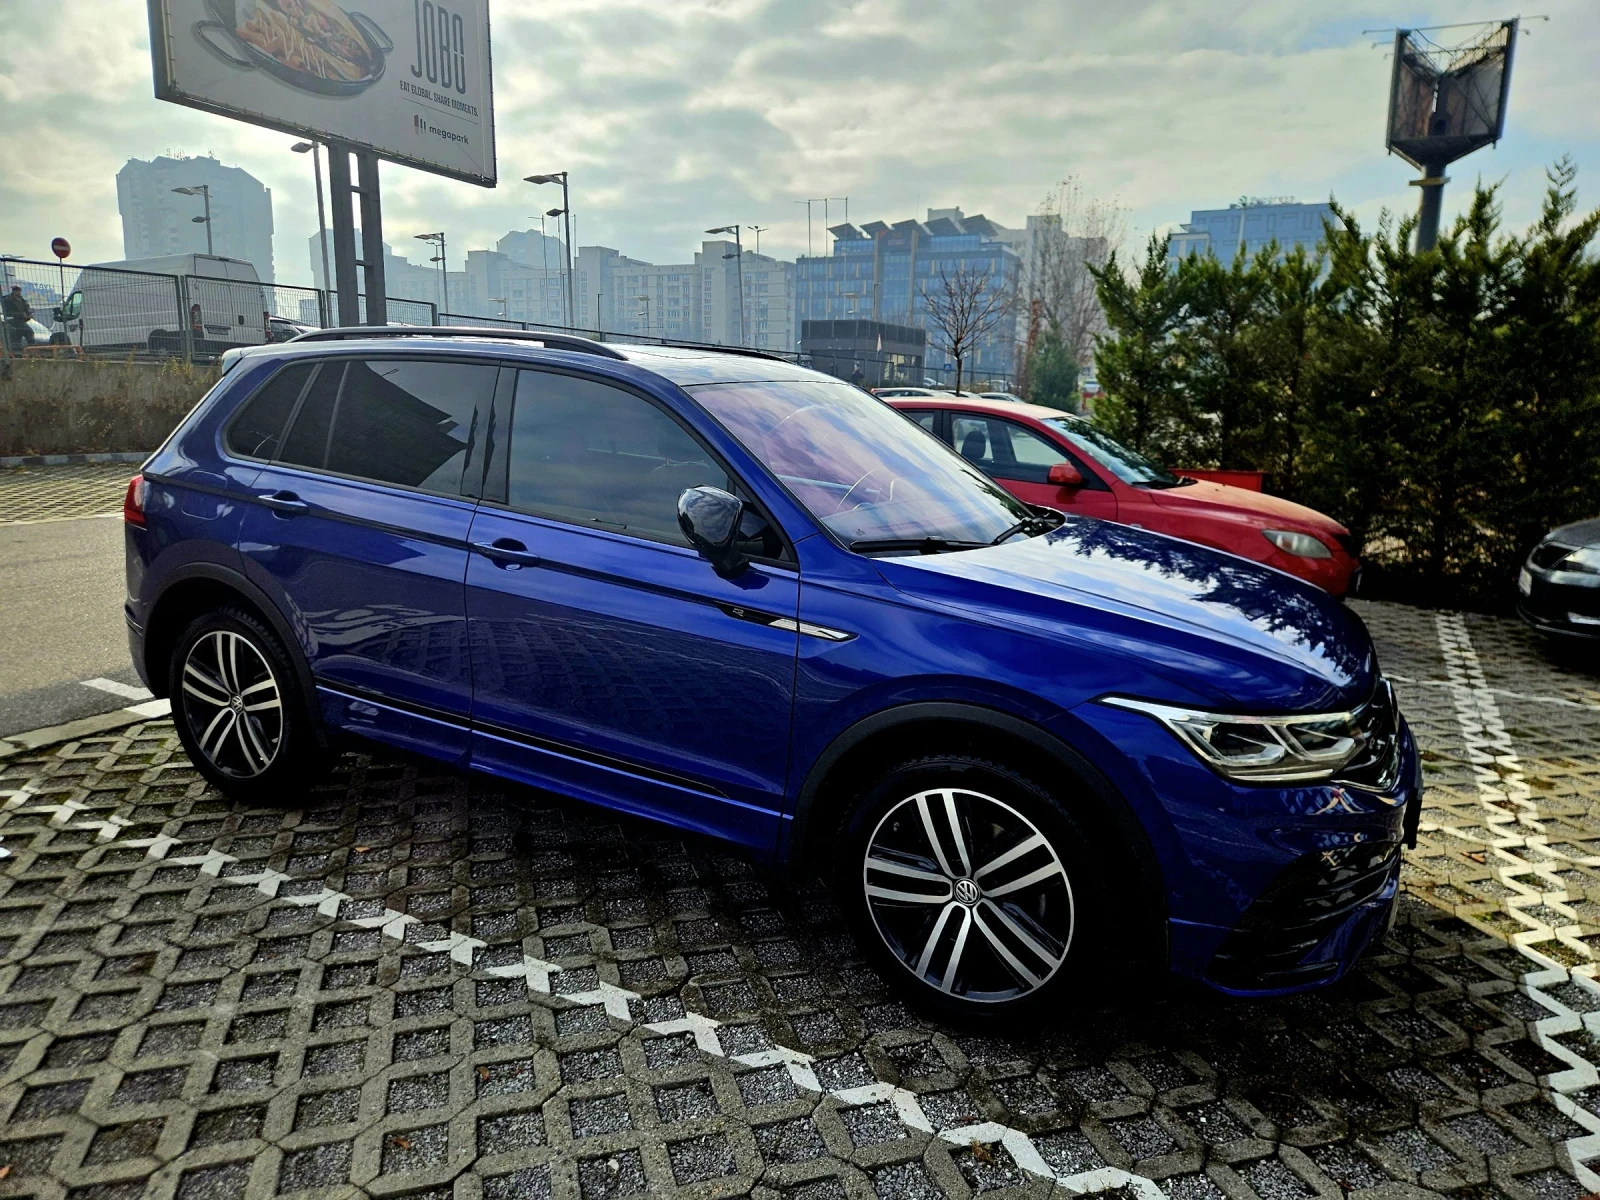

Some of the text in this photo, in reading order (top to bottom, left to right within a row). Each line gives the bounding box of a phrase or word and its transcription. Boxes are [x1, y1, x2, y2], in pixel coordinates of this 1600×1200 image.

[400, 80, 479, 117] EAT GLOBAL. SHARE MOMENTS.
[429, 124, 469, 145] megapark
